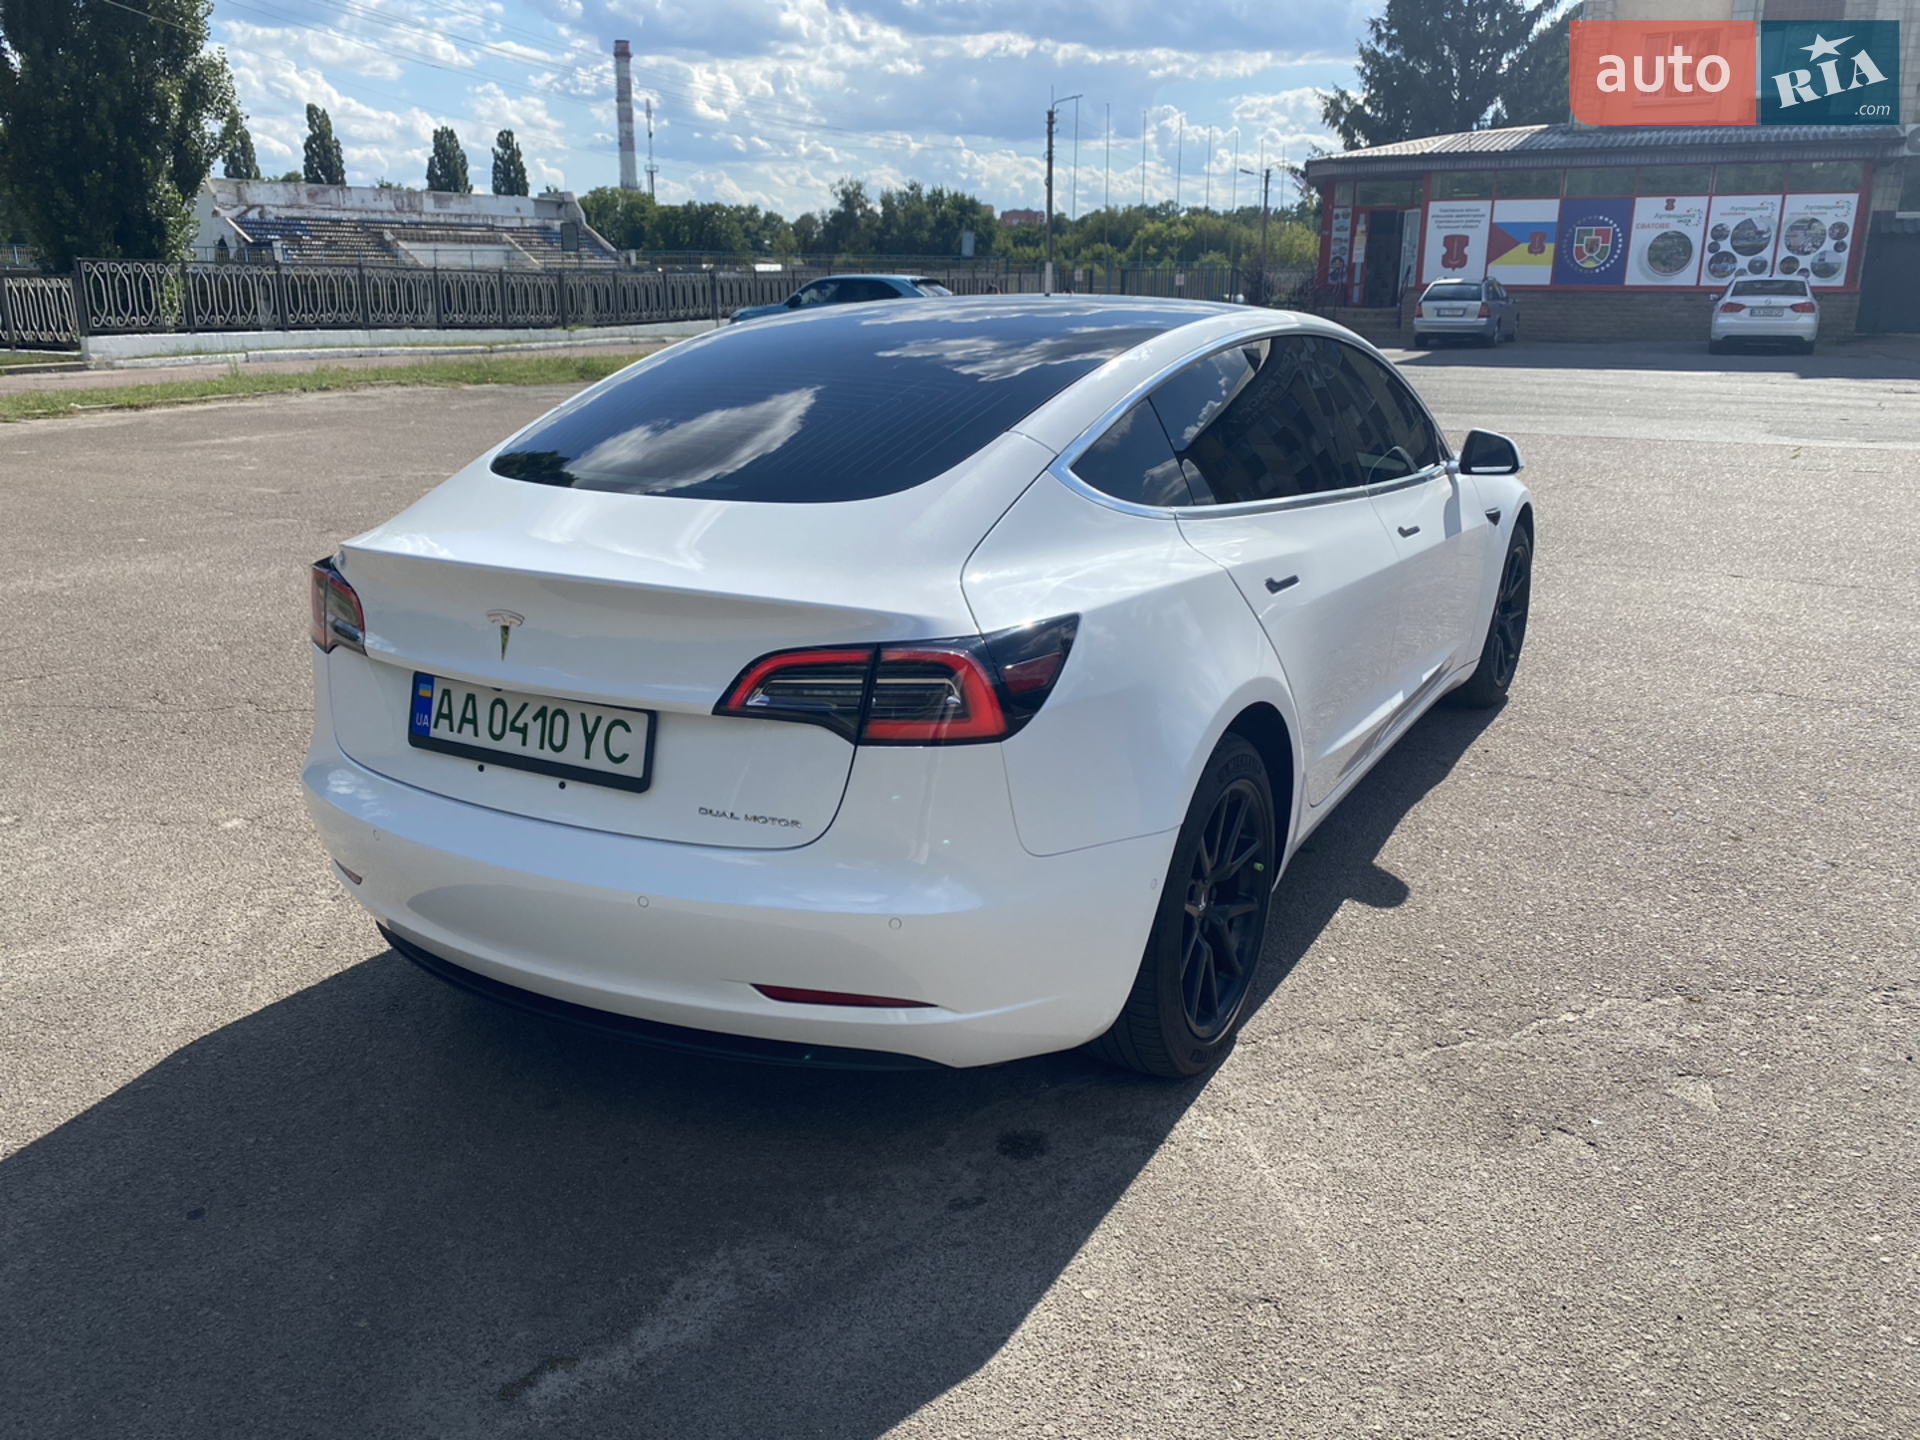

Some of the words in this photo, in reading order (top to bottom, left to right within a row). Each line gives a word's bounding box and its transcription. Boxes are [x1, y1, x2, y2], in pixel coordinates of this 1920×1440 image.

[416, 711, 430, 727] UA
[698, 806, 740, 820] DUAL
[744, 813, 802, 829] MOTOR
